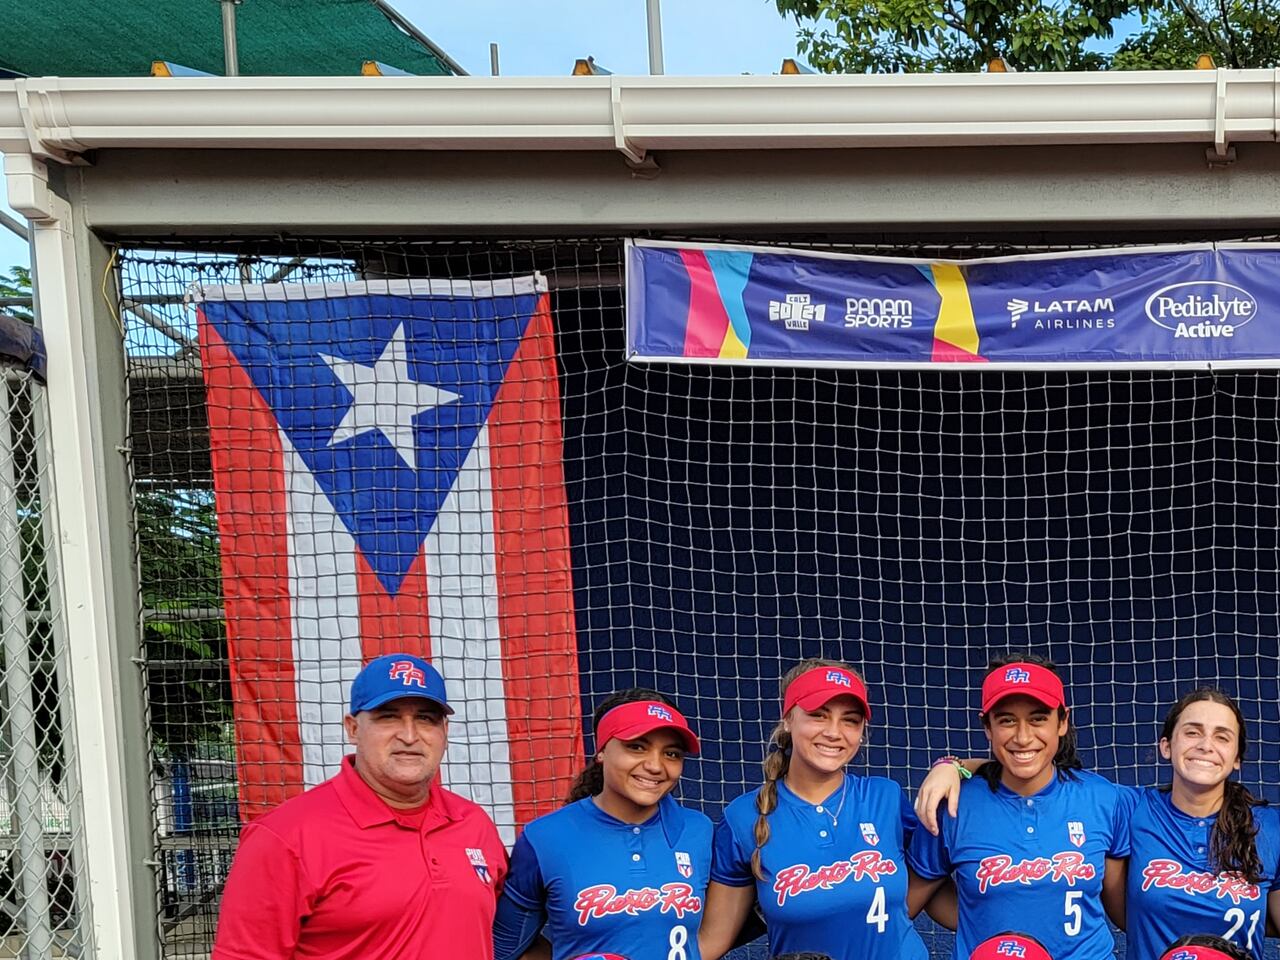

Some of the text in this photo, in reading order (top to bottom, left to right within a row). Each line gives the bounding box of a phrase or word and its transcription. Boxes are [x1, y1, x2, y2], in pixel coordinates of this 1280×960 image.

[844, 315, 913, 328] SPORTS
[846, 298, 912, 315] PANAM
[1034, 298, 1115, 315] LATAM
[1156, 292, 1254, 324] Pedialyte
[1034, 317, 1115, 330] AIRLINES
[1174, 321, 1233, 338] Active
[773, 850, 897, 906] Puerto Rico
[976, 851, 1095, 894] Puerto Rico
[1142, 859, 1219, 892] Puerto
[574, 883, 702, 926] Puerto Rico
[867, 887, 888, 933] 4
[1064, 890, 1082, 936] 5
[1223, 908, 1261, 950] 21
